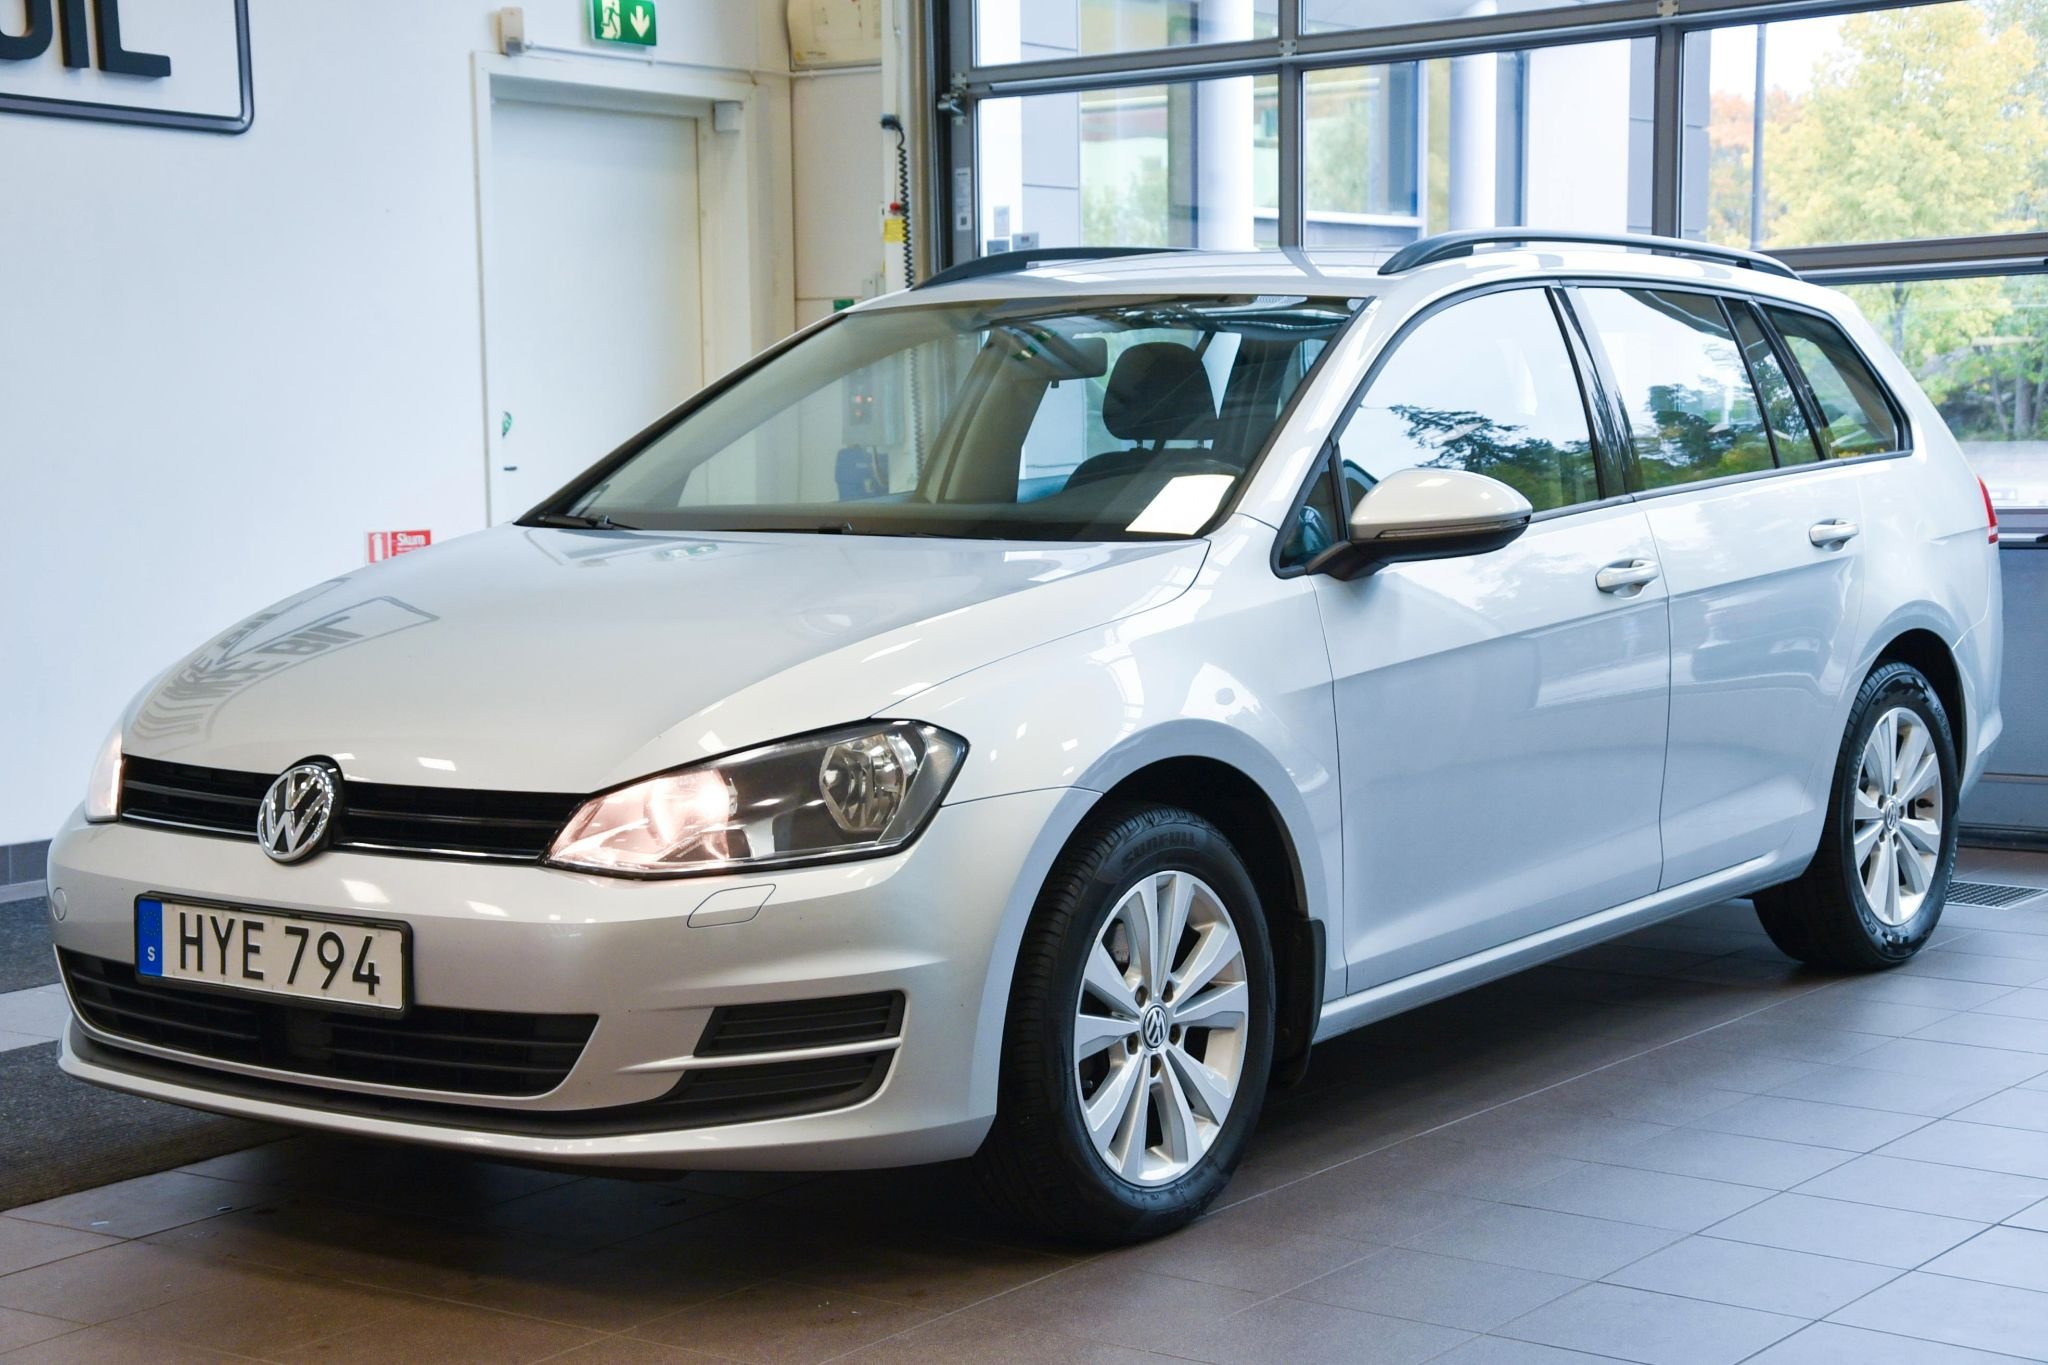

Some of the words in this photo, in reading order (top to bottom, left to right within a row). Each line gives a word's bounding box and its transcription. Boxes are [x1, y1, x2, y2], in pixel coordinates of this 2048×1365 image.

[146, 946, 156, 962] S
[179, 911, 265, 981] HYE
[284, 924, 381, 996] 794
